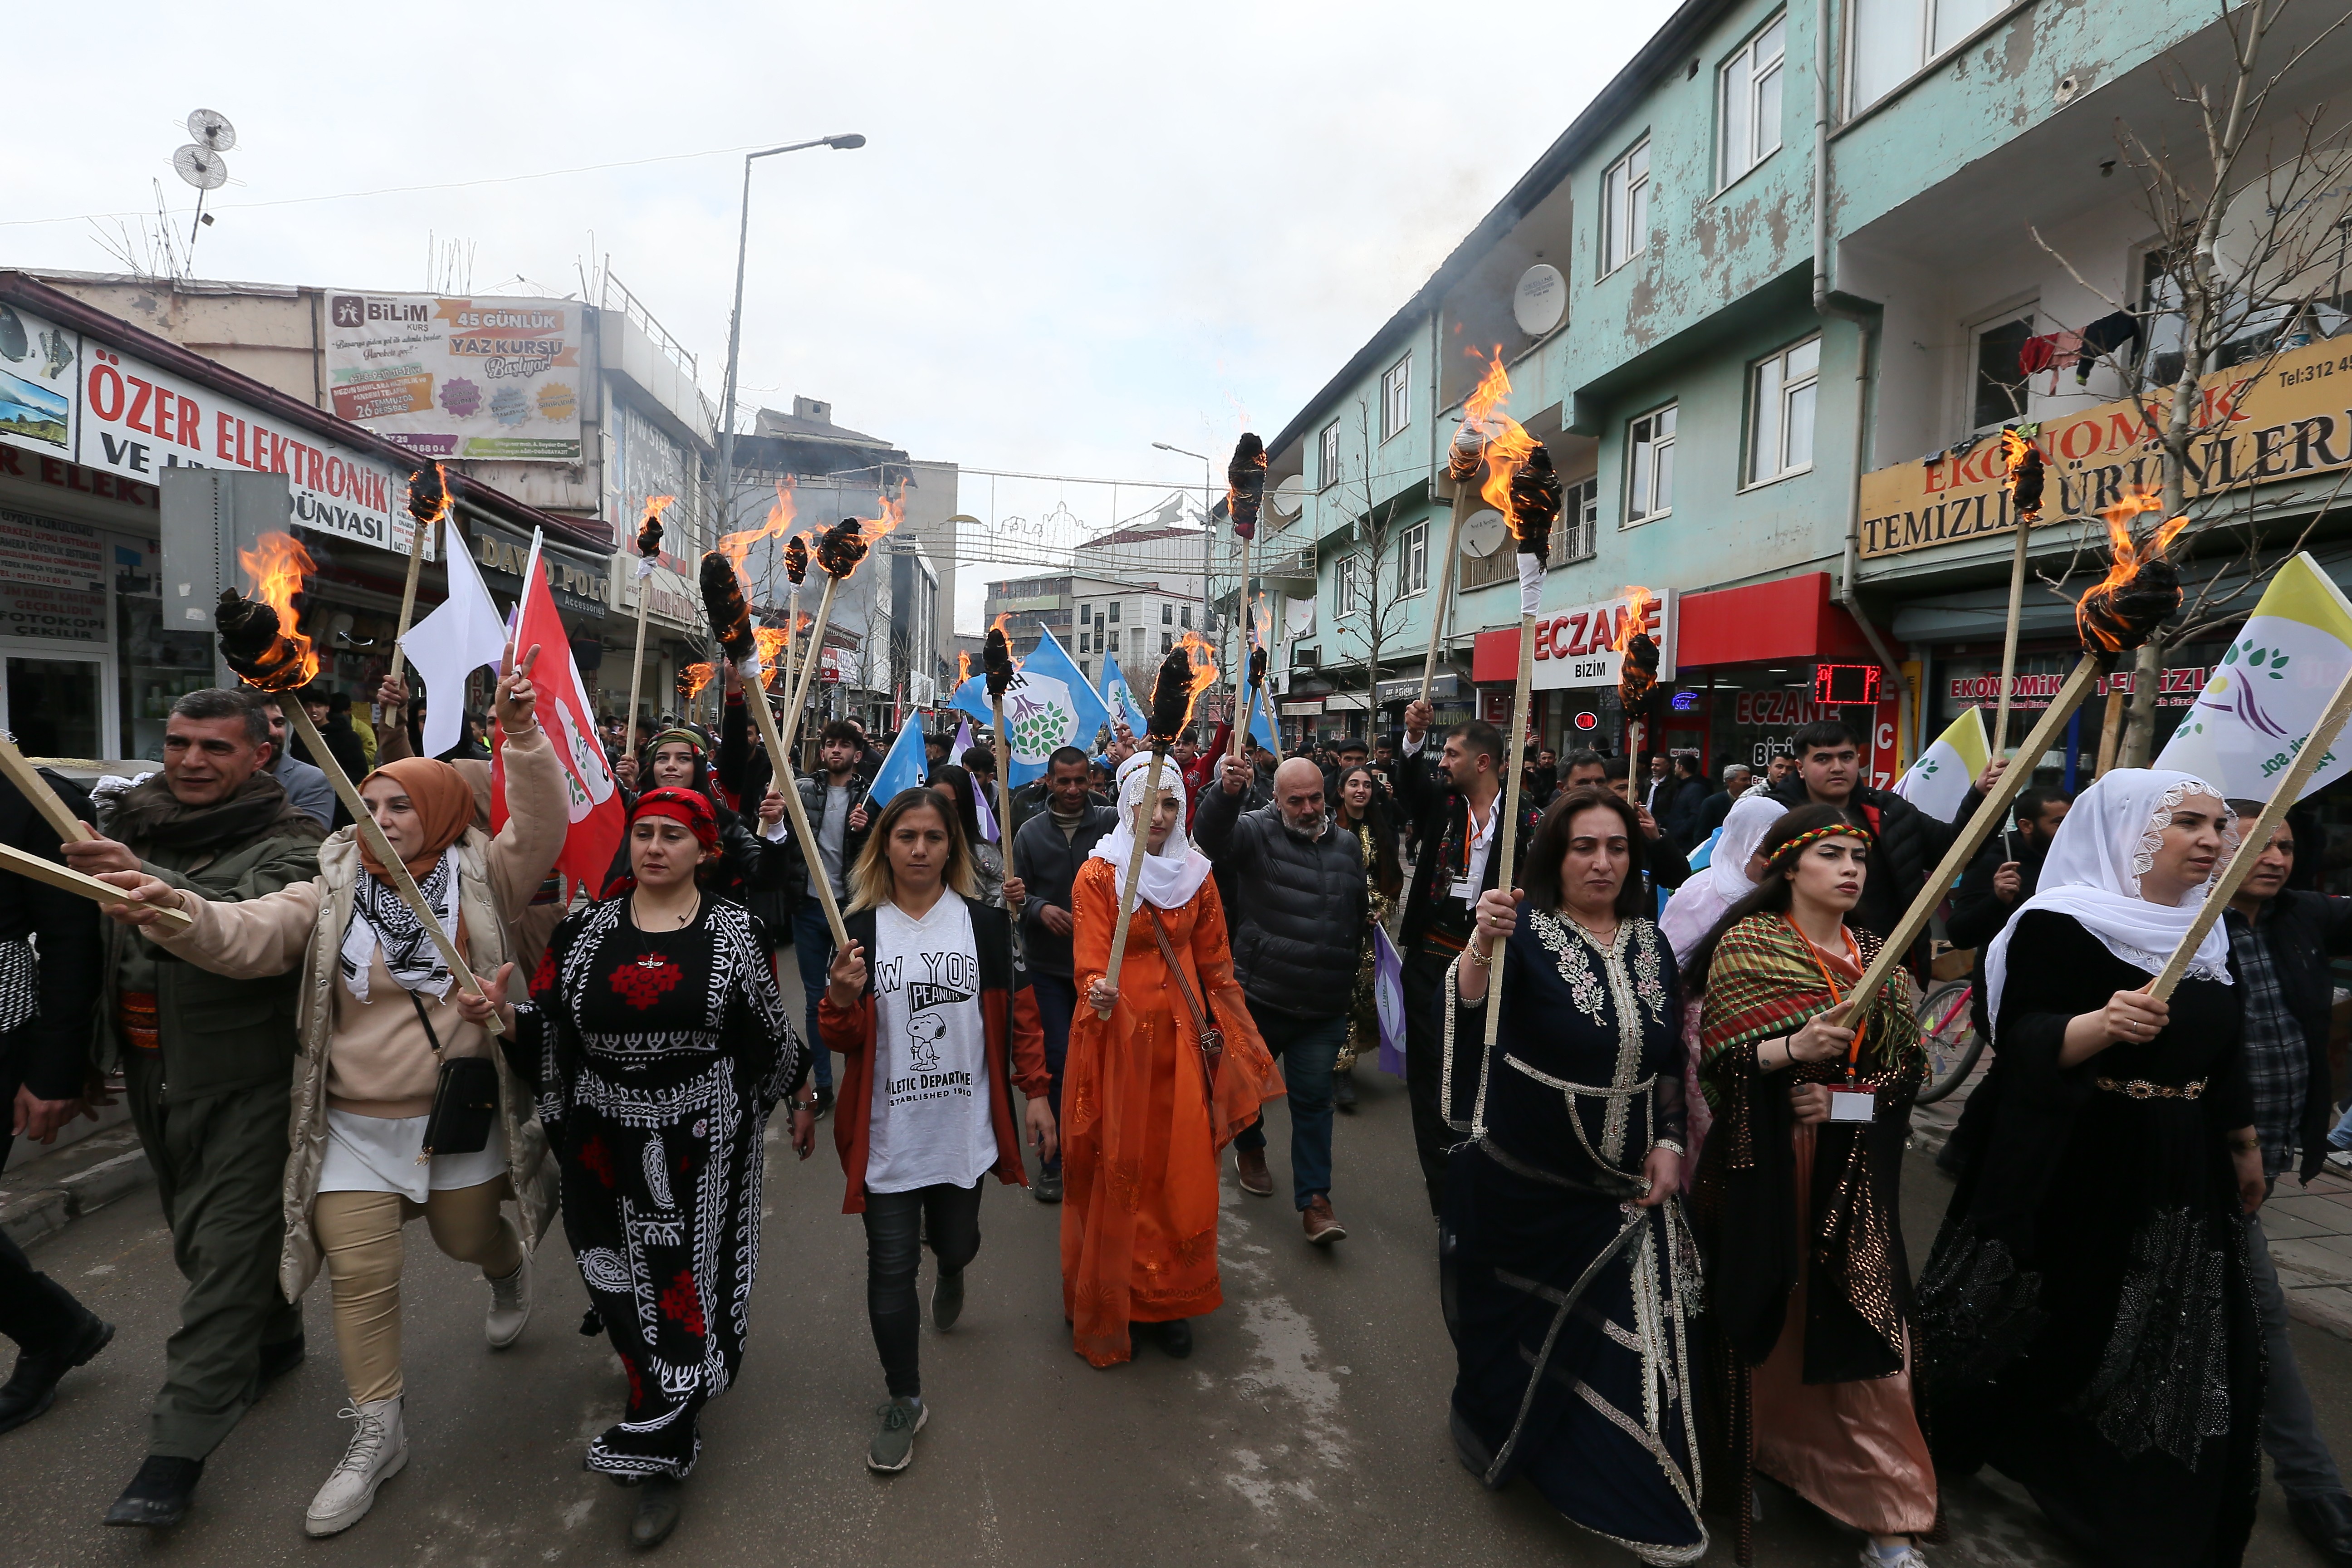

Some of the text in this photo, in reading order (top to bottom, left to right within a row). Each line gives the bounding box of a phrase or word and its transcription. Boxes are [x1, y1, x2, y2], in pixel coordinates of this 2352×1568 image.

[407, 324, 429, 332] KURS
[457, 309, 556, 328] 45 GÜNLÜK
[451, 339, 563, 356] YAZ KURSU
[88, 348, 201, 451] ÖZER
[356, 404, 373, 418] 26
[100, 431, 150, 475] VE
[1, 511, 94, 537] UYDU KURULUMU
[34, 531, 58, 542] UYDU
[482, 533, 610, 604] DAVD POLO
[37, 575, 50, 583] 312
[564, 595, 605, 616] Accessories
[15, 625, 93, 640] ÇEKİLİR
[1575, 659, 1606, 678] BİZİM
[1675, 700, 1690, 710] SGK
[920, 952, 980, 996] YOR
[912, 984, 960, 1009] PEANUTS
